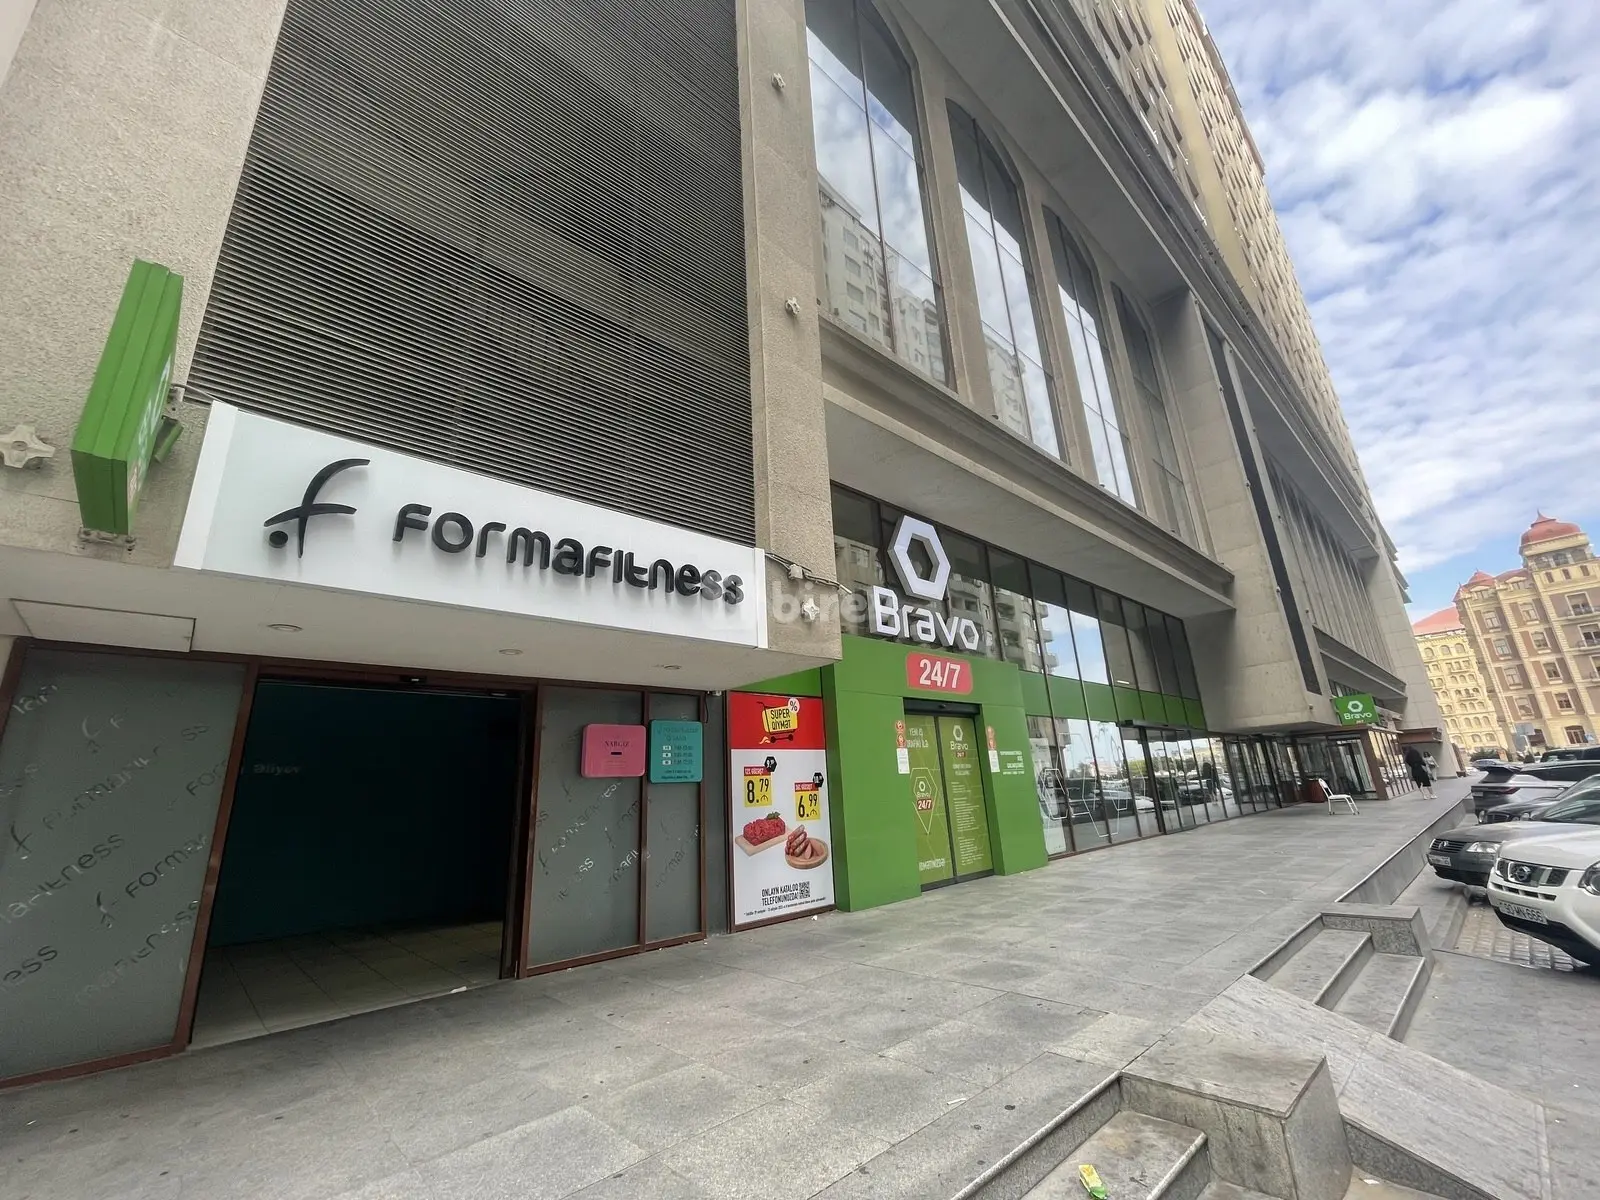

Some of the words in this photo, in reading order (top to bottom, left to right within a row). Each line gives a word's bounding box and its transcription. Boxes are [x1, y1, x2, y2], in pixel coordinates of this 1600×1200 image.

[868, 584, 979, 651] Bravo
[918, 657, 962, 690] 24/7
[770, 708, 791, 720] SUPER
[1343, 711, 1373, 721] Bravo
[950, 740, 969, 751] Bravo
[917, 799, 932, 810] 24/7
